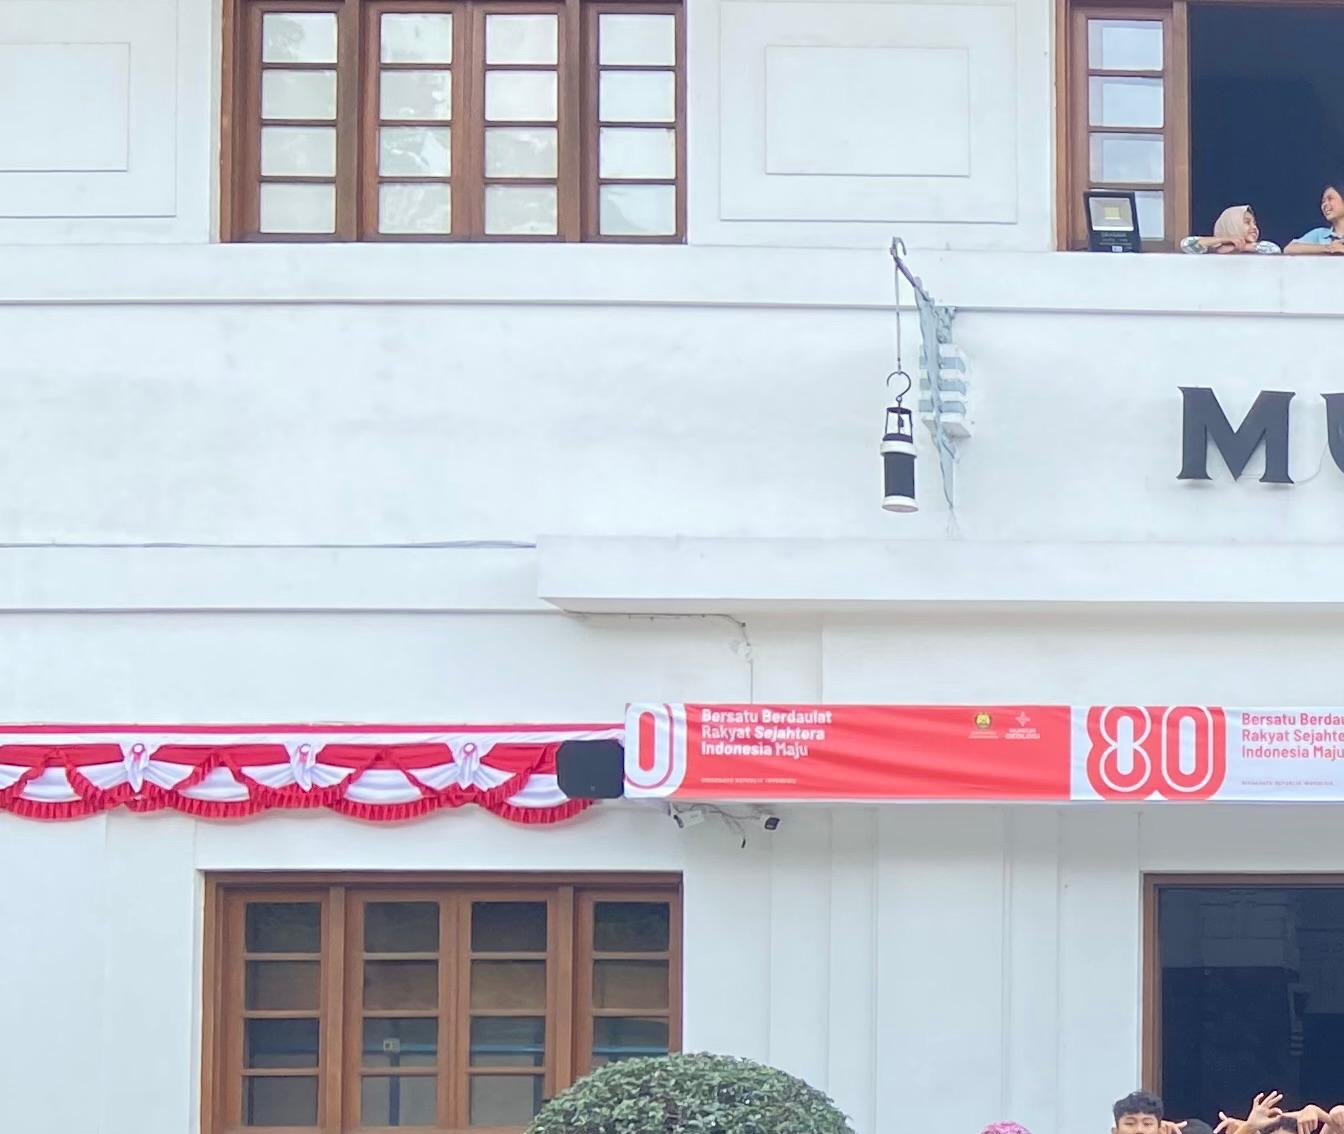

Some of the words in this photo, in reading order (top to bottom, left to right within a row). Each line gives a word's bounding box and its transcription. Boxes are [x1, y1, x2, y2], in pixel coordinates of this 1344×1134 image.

[701, 709, 758, 723] Bersatu
[761, 709, 832, 724] Berdaulat
[1241, 712, 1296, 726] Bersatu
[701, 725, 751, 742] Rakyat
[754, 726, 825, 743] Sejahtera
[1241, 729, 1290, 745] Rakyat
[701, 742, 772, 756] Indonesia
[775, 743, 808, 760] Maju
[1086, 705, 1228, 800] 80
[1241, 745, 1310, 758] Indonesia
[1313, 745, 1344, 762] Maju
